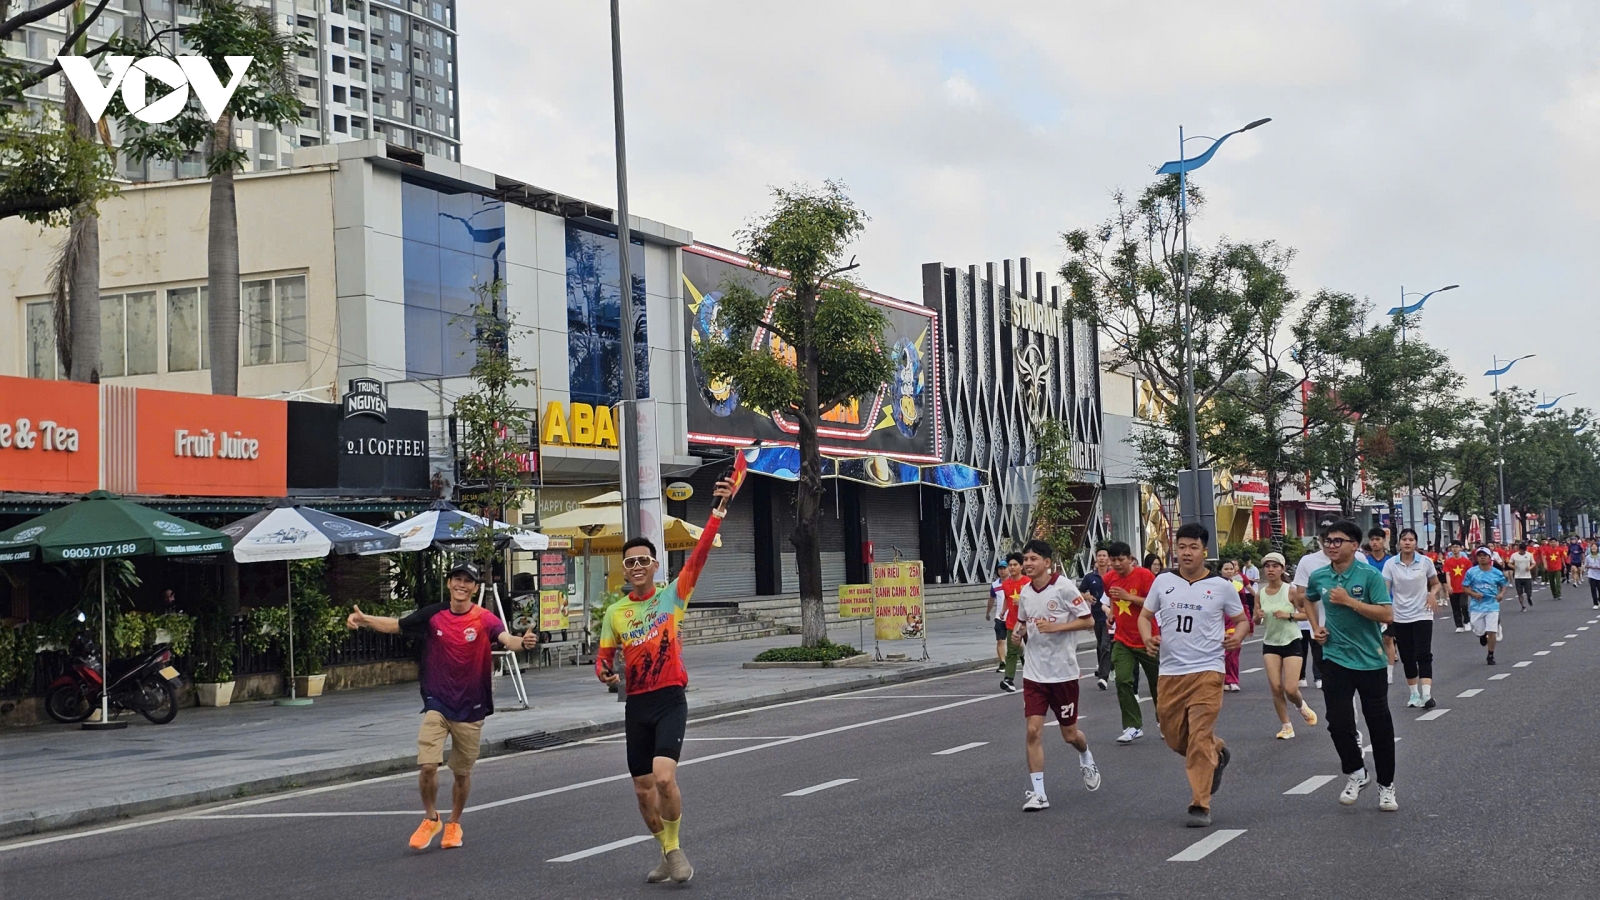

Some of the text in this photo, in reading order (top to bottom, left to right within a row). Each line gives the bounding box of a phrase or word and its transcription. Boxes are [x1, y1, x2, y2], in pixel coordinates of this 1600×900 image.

[357, 382, 380, 394] TRUNG
[571, 402, 619, 447] BA
[14, 418, 37, 450] &
[38, 420, 79, 452] Tea
[174, 429, 259, 460] Fruit Juice
[368, 438, 425, 457] COFFEE!
[539, 499, 564, 512] HAPPY
[62, 543, 136, 559] 0909.707.189
[892, 586, 907, 597] CANH
[909, 586, 920, 597] 20K
[1176, 603, 1203, 611] 日本生命
[1176, 615, 1194, 634] 10
[1060, 702, 1075, 719] 27
